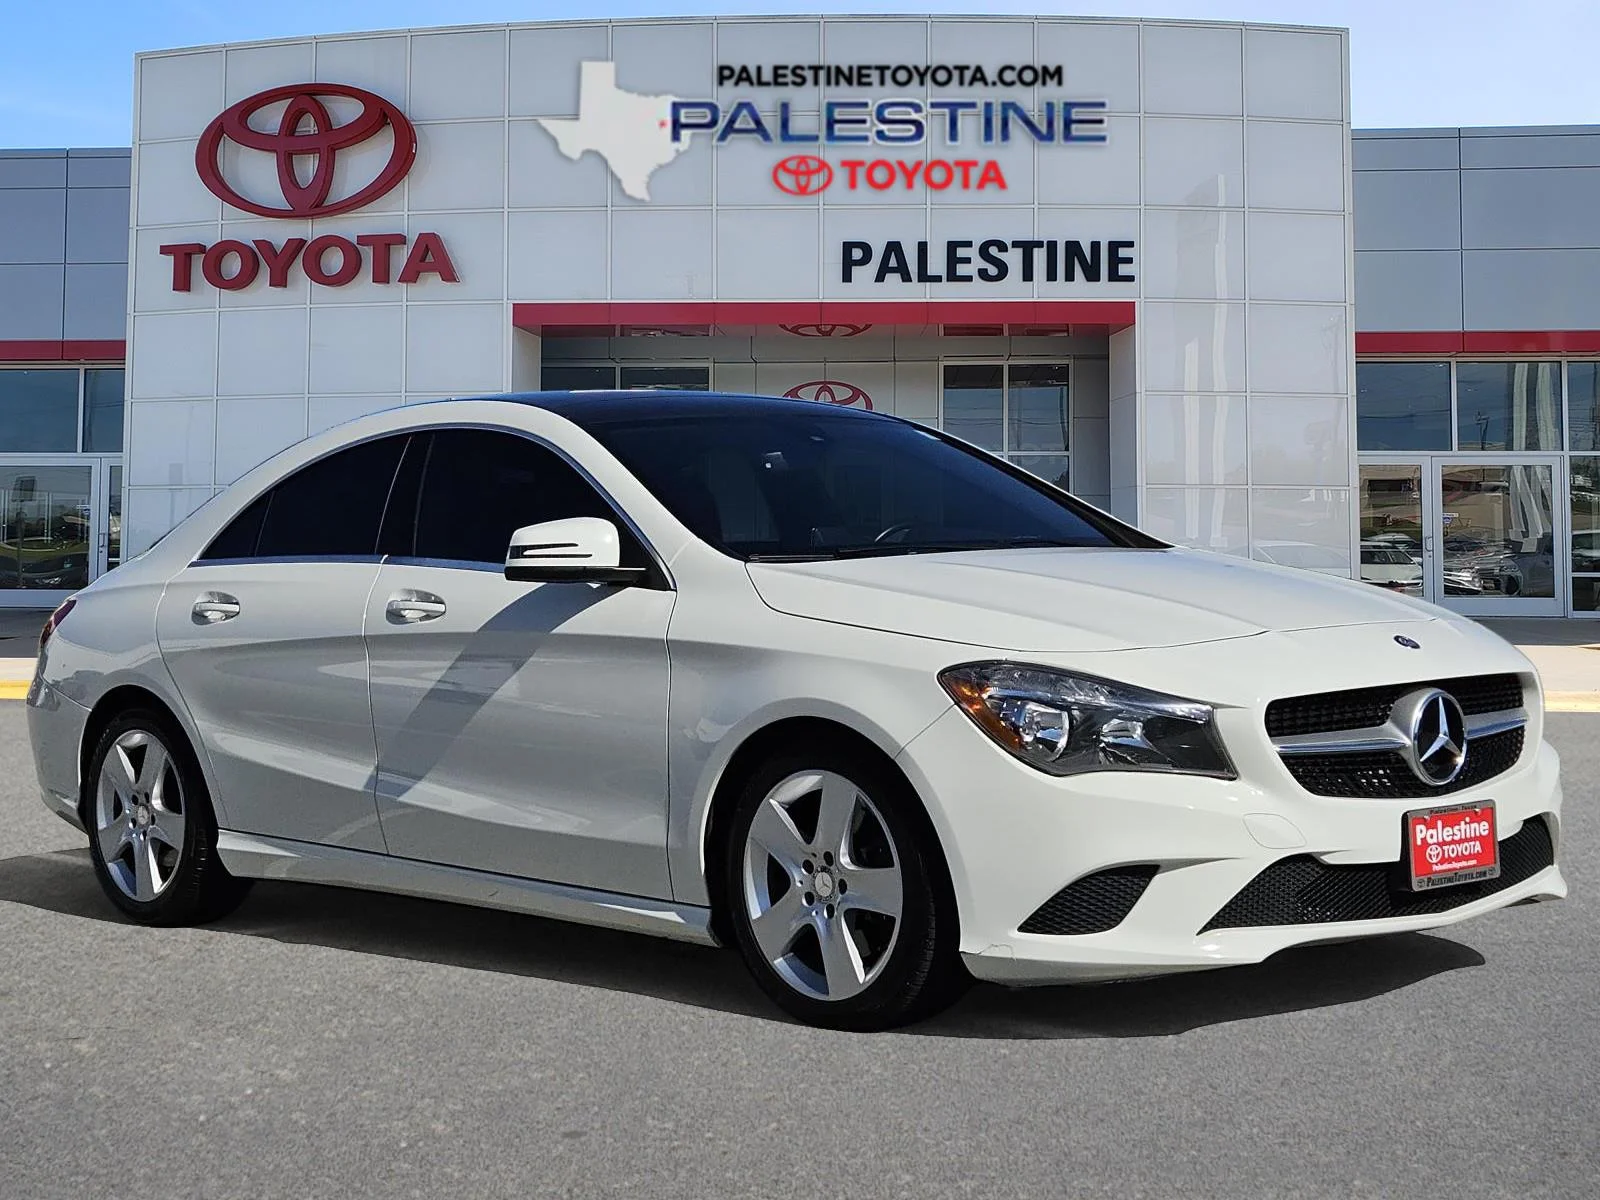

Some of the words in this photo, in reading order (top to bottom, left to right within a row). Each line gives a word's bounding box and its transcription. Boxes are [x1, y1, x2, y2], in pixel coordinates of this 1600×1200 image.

[159, 231, 461, 292] TOYOTA
[841, 239, 1137, 283] PALESTINE
[1415, 816, 1490, 846] Palestine
[1443, 841, 1483, 859] TOYOTA
